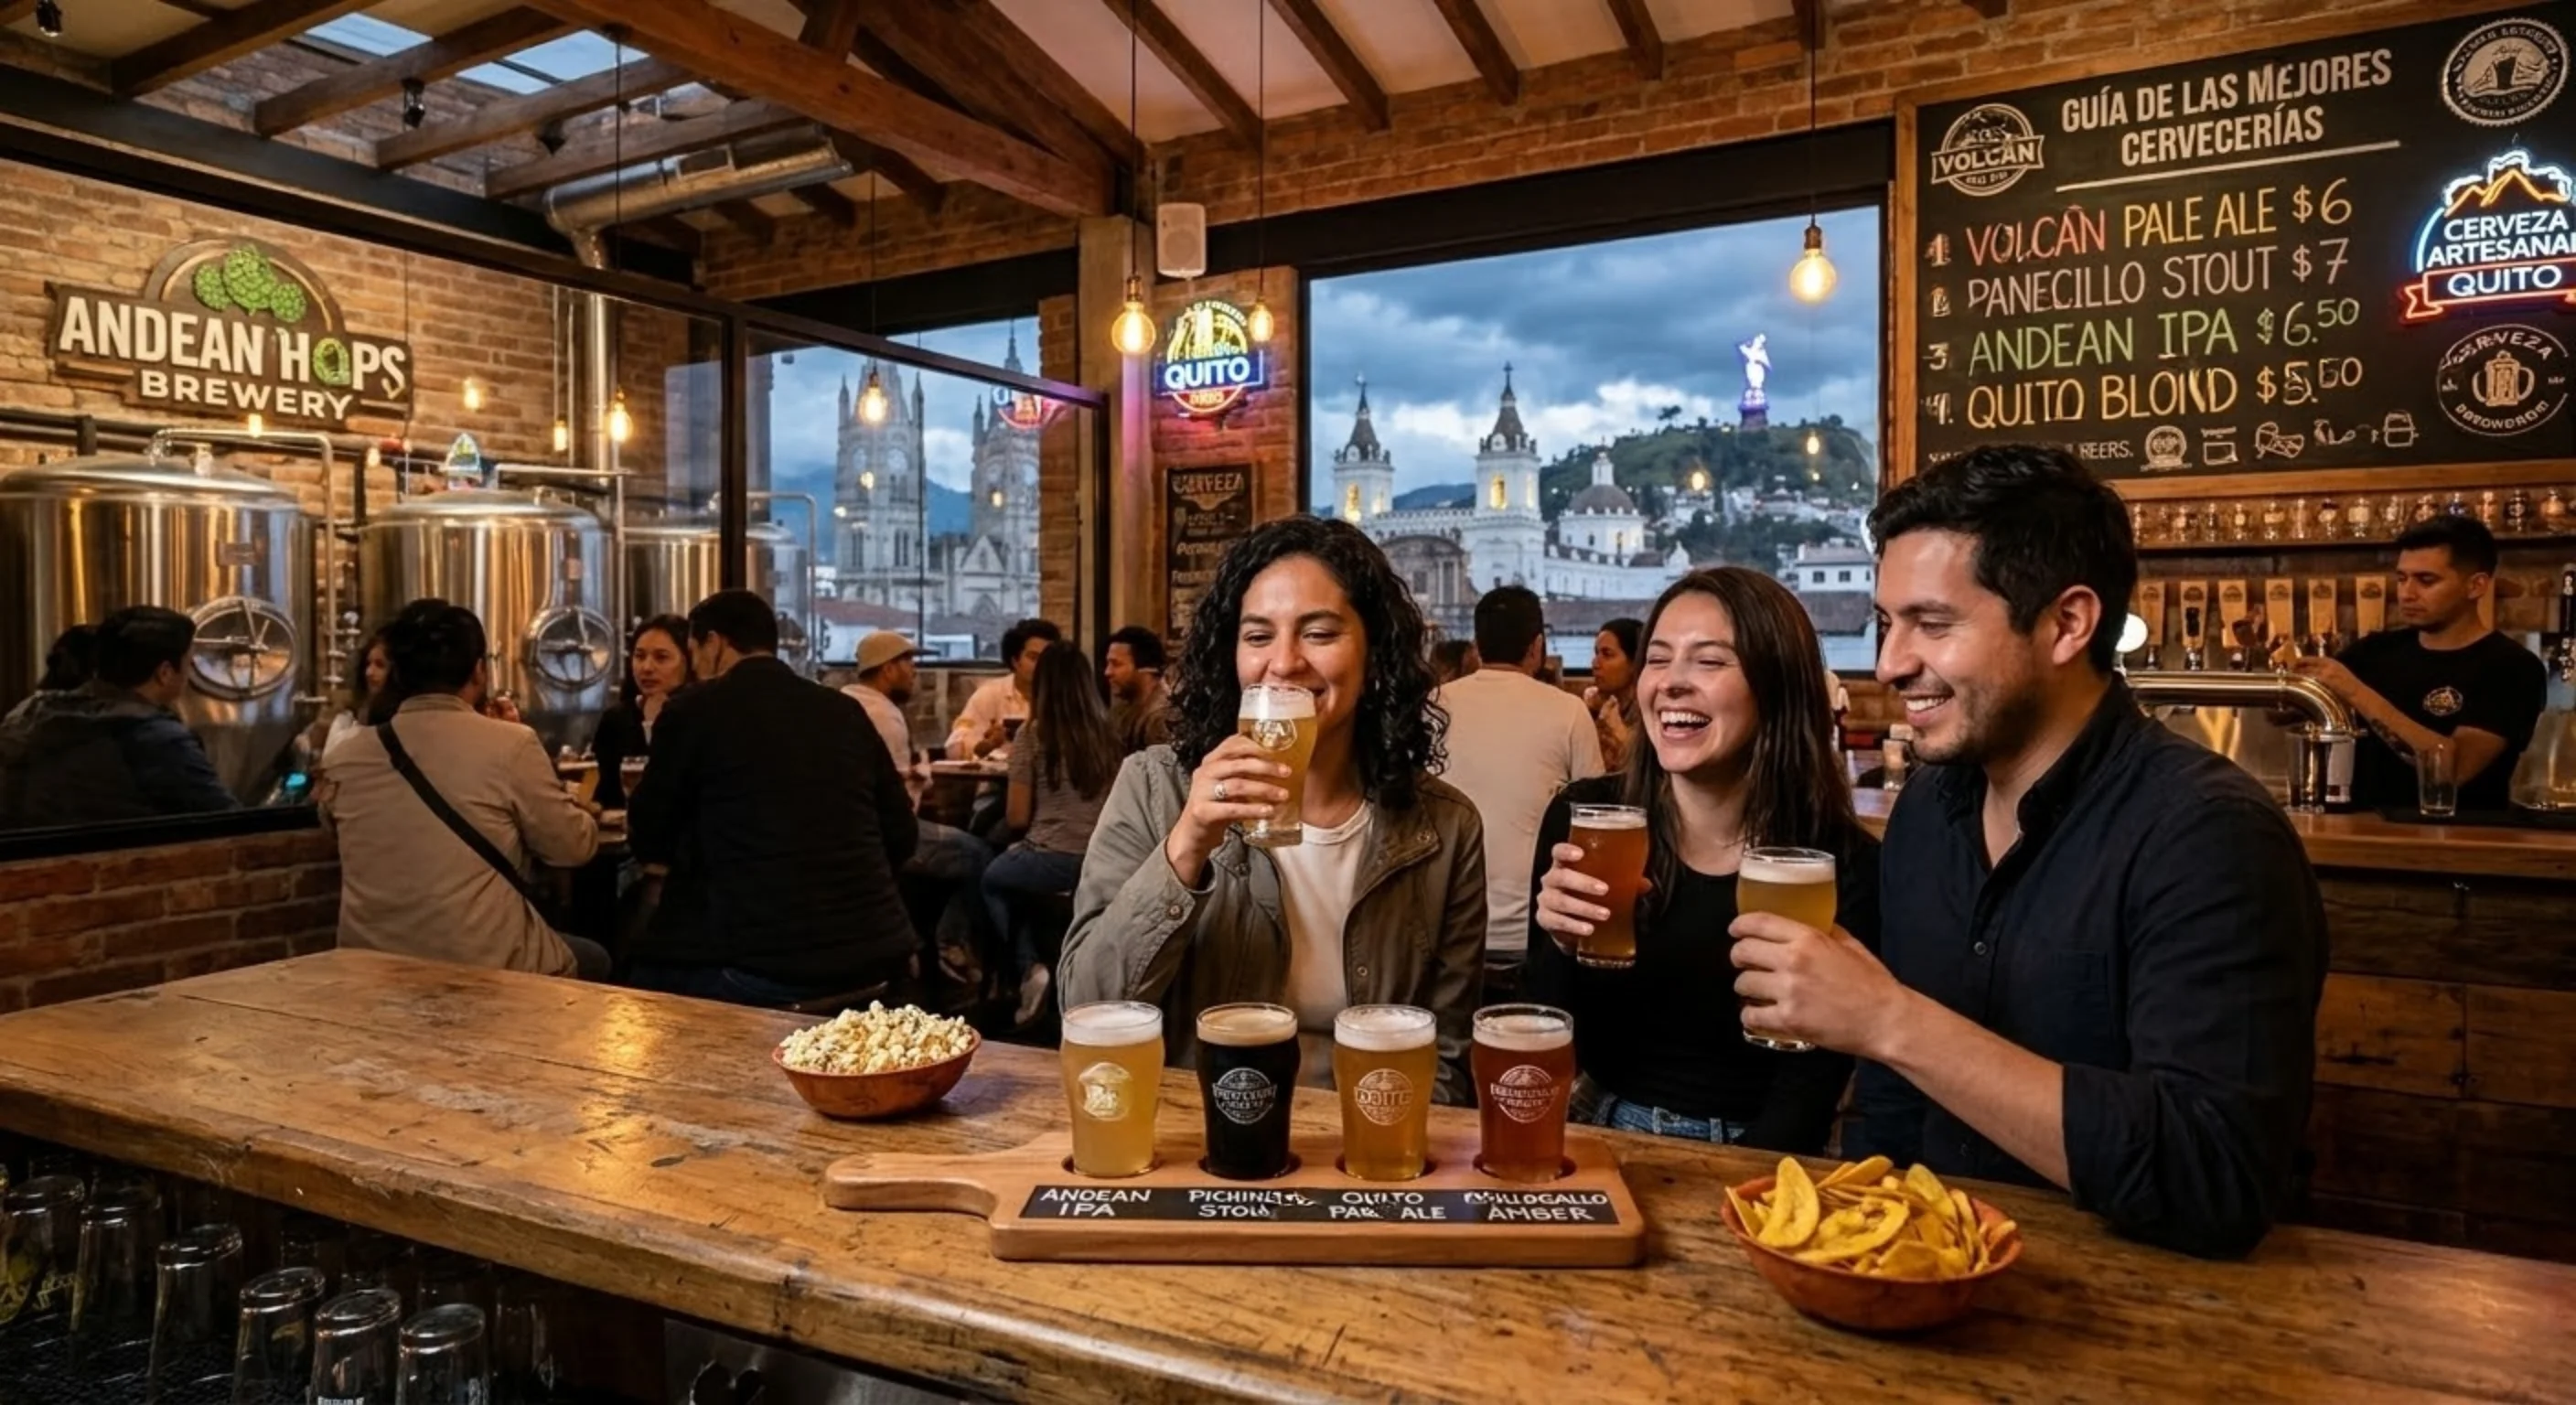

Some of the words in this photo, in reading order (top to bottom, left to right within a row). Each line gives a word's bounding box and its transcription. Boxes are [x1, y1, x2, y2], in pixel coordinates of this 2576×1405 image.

[2062, 85, 2128, 133] GUÍA
[2136, 84, 2174, 122] DE
[2183, 73, 2238, 113] LAS
[2248, 48, 2393, 105] MEJORES
[2120, 102, 2324, 166] CERVECERÍAS
[2124, 195, 2204, 249] PALE
[2214, 187, 2277, 239] ALE
[2443, 209, 2570, 242] CERVEZA
[1968, 261, 2145, 318] PANECILLO
[2162, 245, 2279, 299] STOUT
[2447, 264, 2562, 297] QUITO
[59, 295, 265, 376] ANDEAN
[275, 326, 406, 400] HOPS
[1968, 317, 2134, 377] ANDEAN
[2157, 306, 2239, 359] IPA
[140, 370, 354, 421] BREWERY
[1164, 356, 1250, 391] QUITO
[1968, 378, 2087, 429] QUITO
[1058, 1202, 1115, 1217] IPA
[1401, 1207, 1447, 1220] ALE
